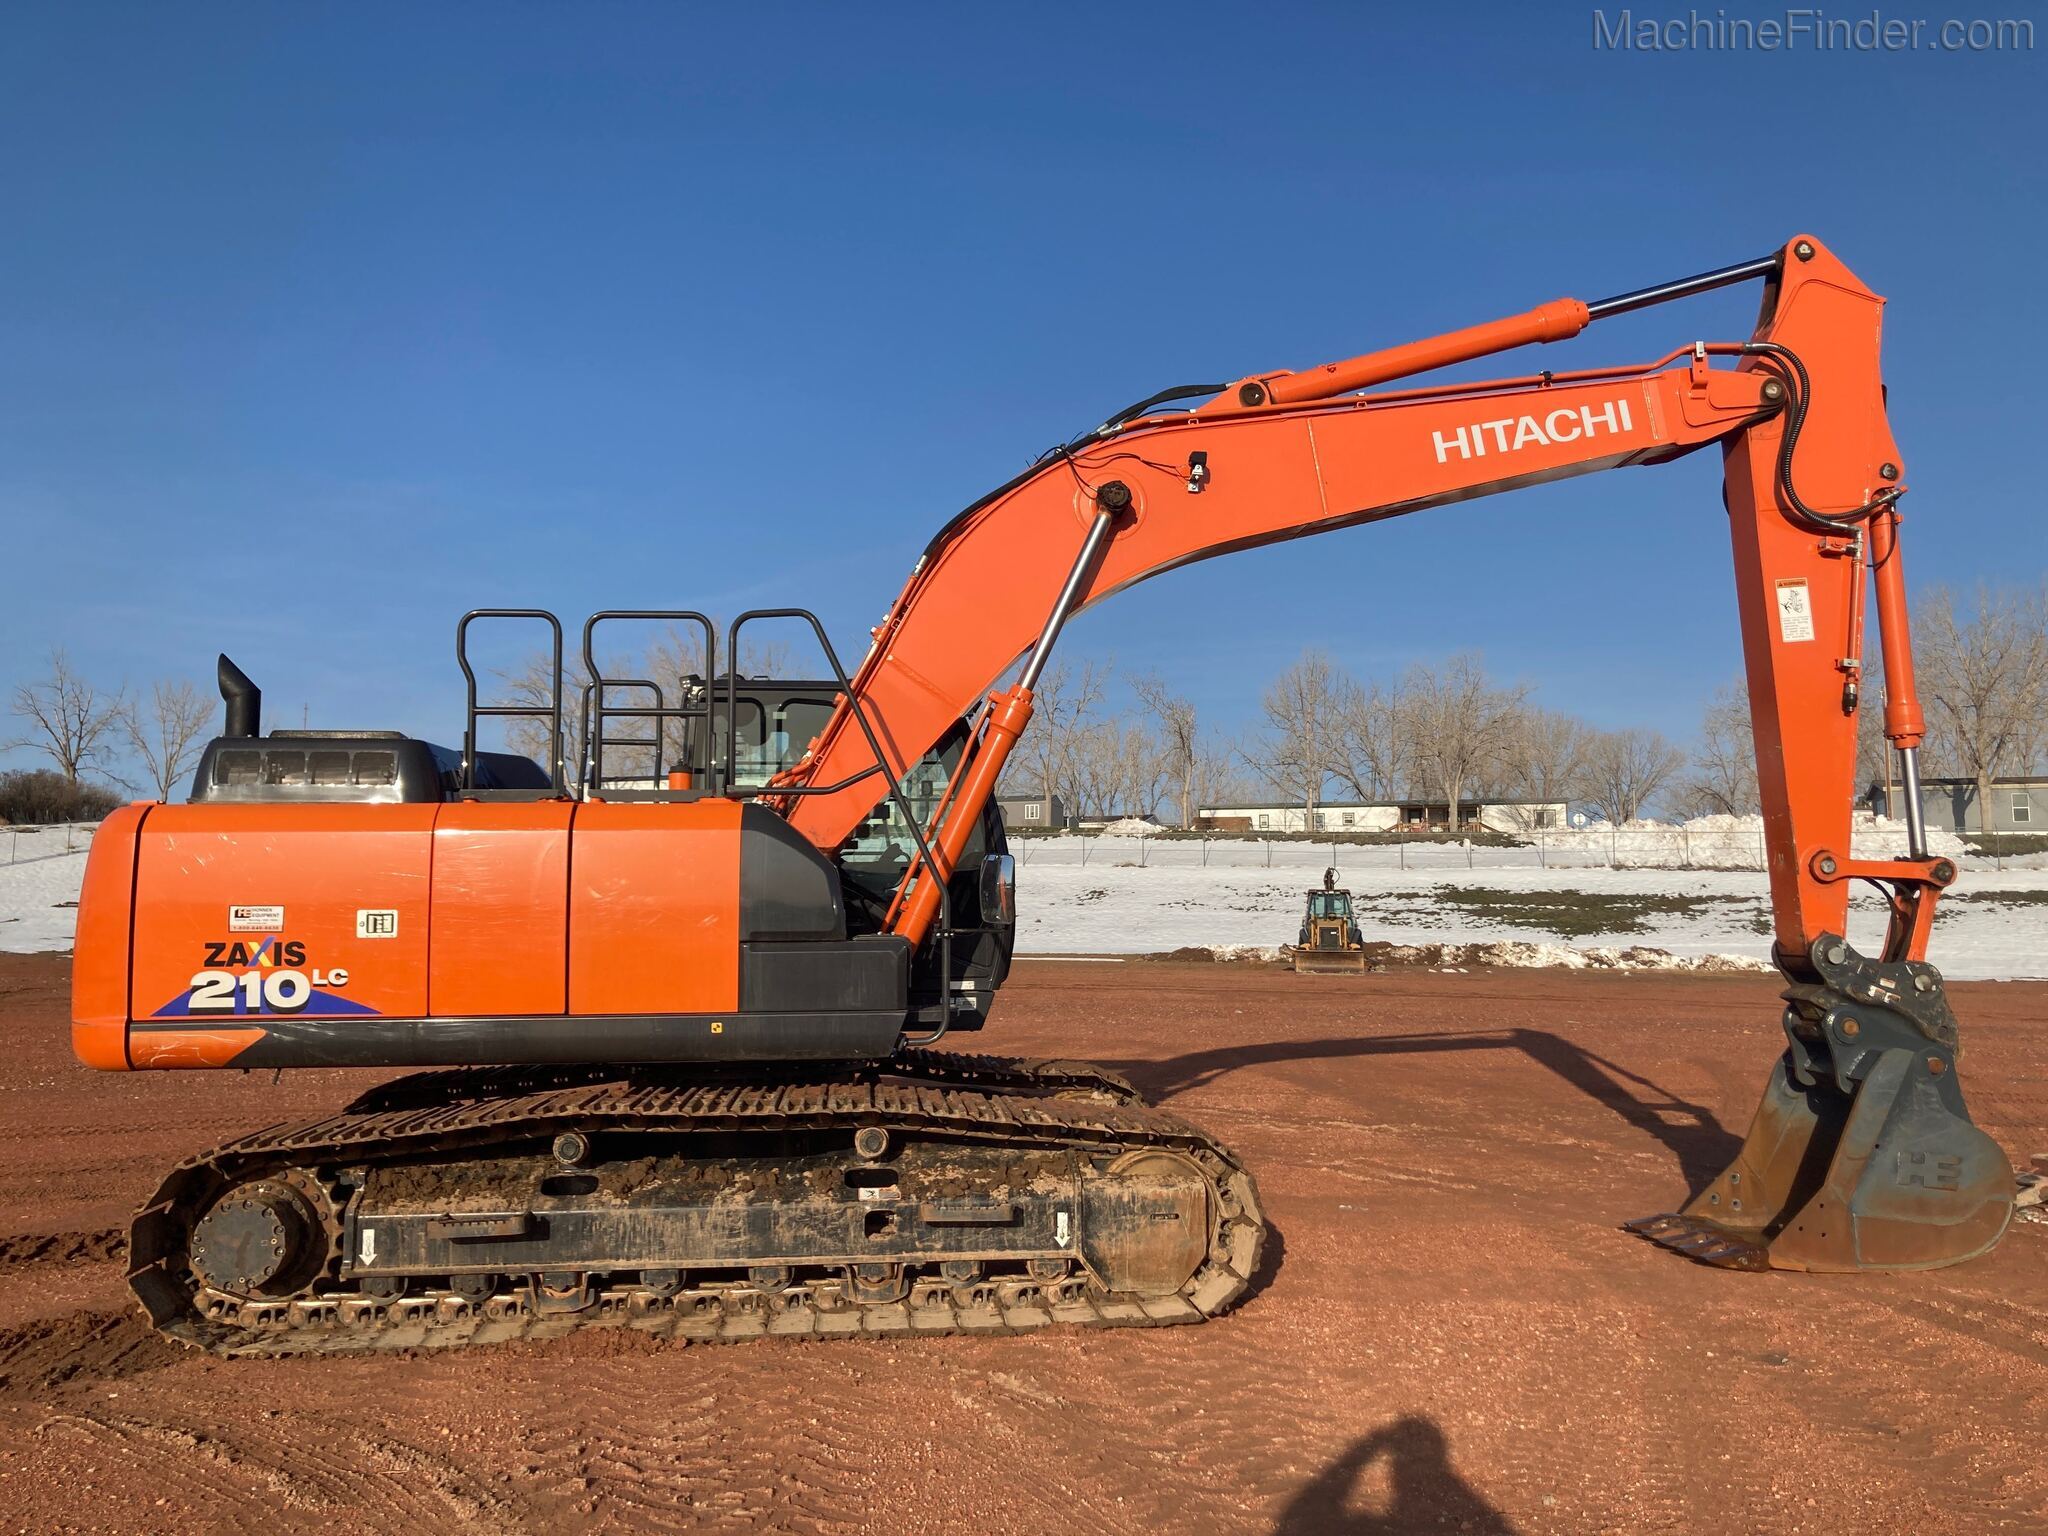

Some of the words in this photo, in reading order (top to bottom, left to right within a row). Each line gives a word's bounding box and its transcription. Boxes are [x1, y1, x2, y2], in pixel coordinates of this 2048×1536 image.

[1432, 399, 1633, 464] HITACHI
[204, 936, 306, 967] ZAXIS
[188, 970, 311, 1012] 210
[312, 968, 349, 987] LC
